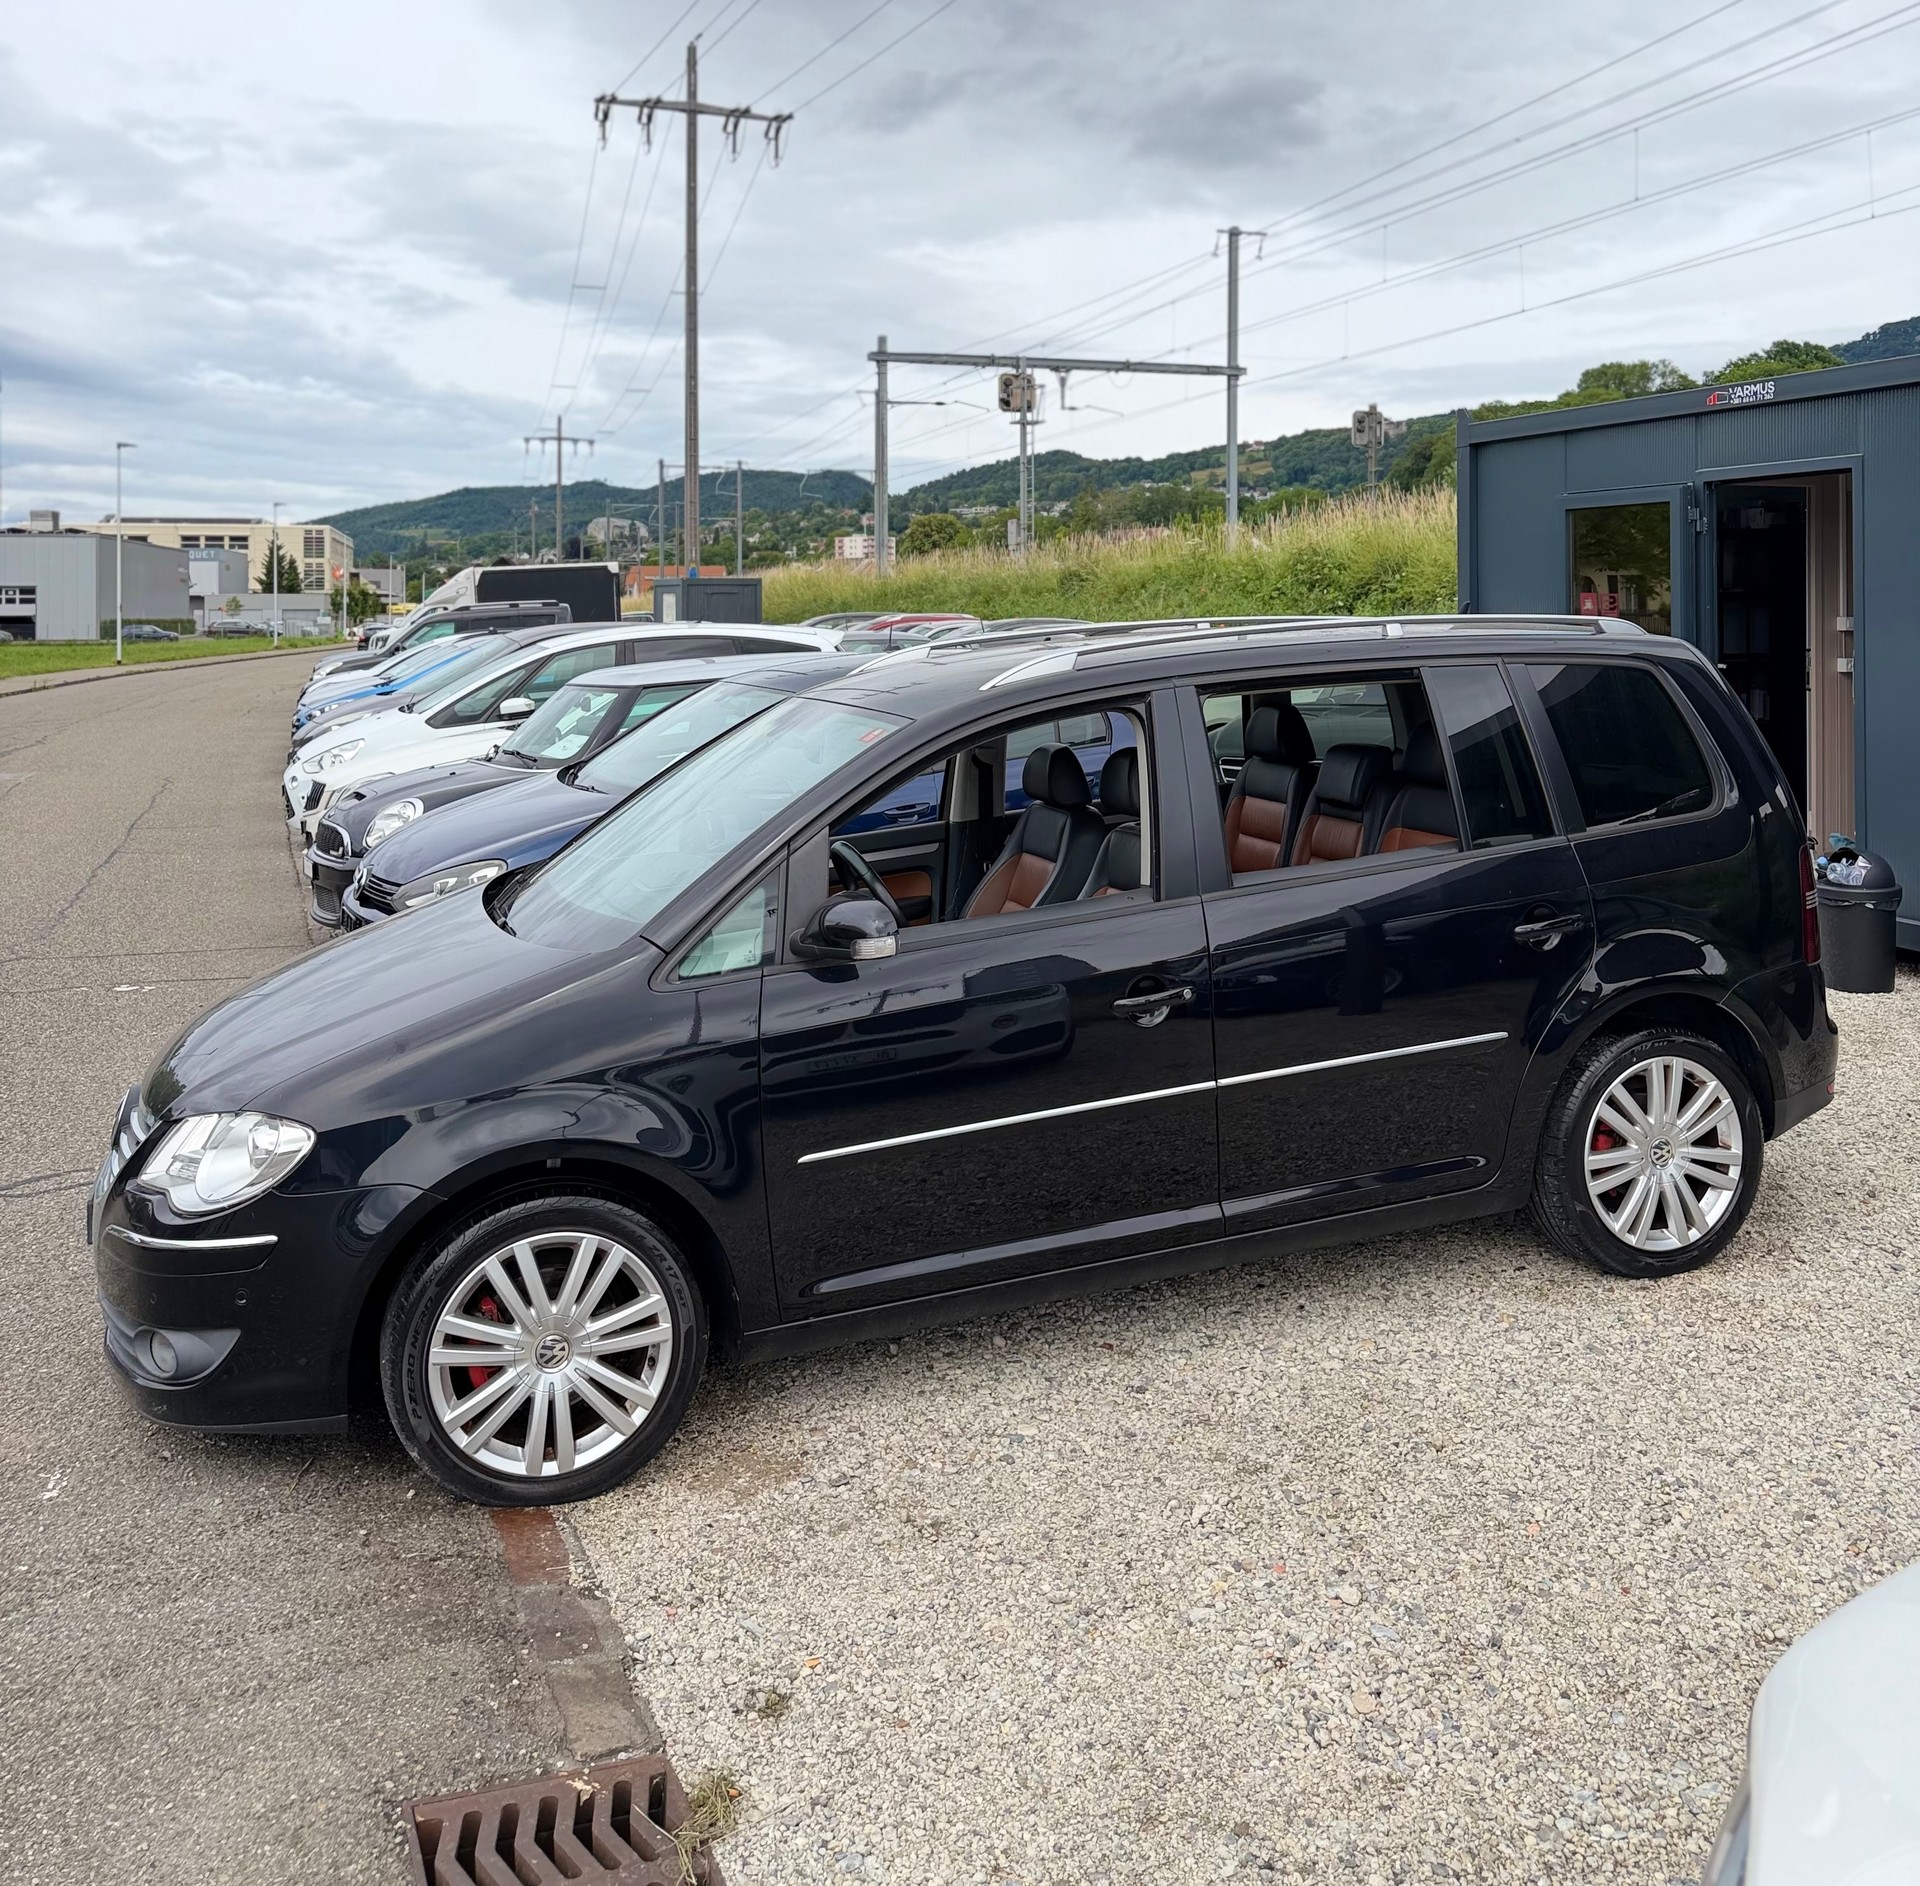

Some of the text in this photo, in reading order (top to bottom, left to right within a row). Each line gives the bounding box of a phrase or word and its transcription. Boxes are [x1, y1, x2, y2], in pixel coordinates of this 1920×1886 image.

[1729, 381, 1775, 398] VARMUS
[188, 550, 215, 560] QUET
[664, 1265, 680, 1281] 17
[410, 1296, 434, 1350] NERO
